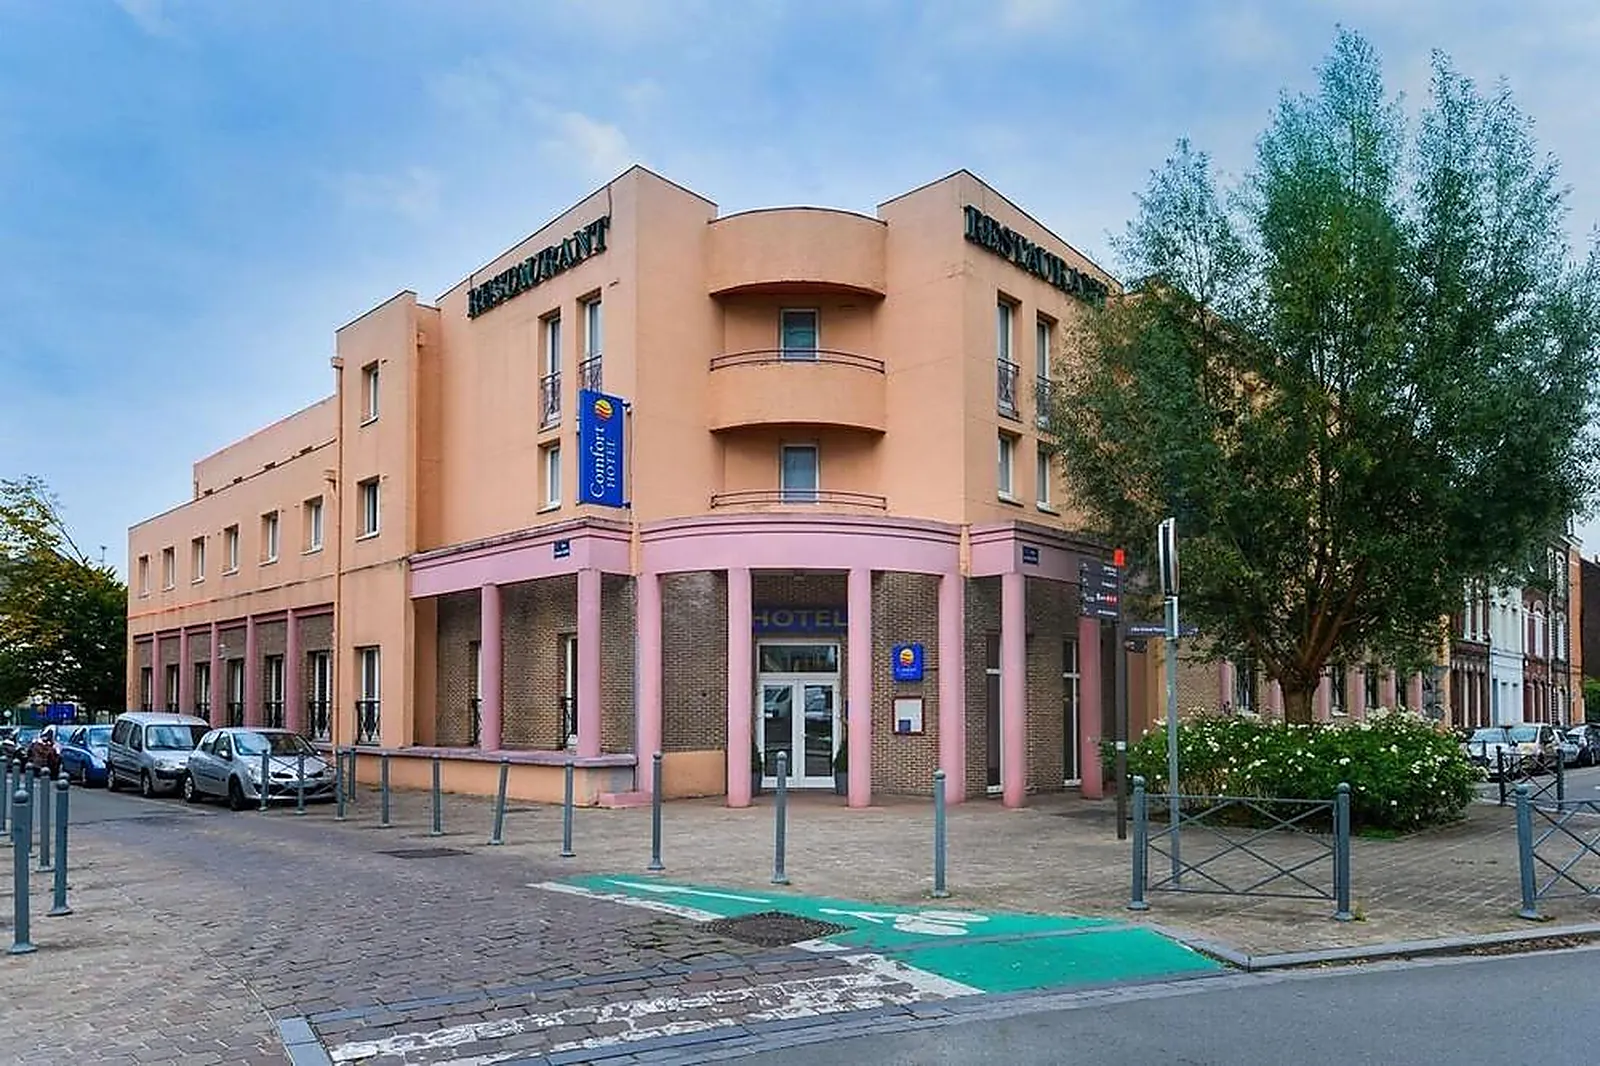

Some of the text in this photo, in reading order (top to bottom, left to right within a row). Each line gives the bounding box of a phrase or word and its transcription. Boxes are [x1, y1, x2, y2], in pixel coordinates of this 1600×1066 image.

[467, 215, 610, 318] RESTAURANT
[590, 426, 605, 498] Comfort
[754, 609, 848, 627] HOTEL
